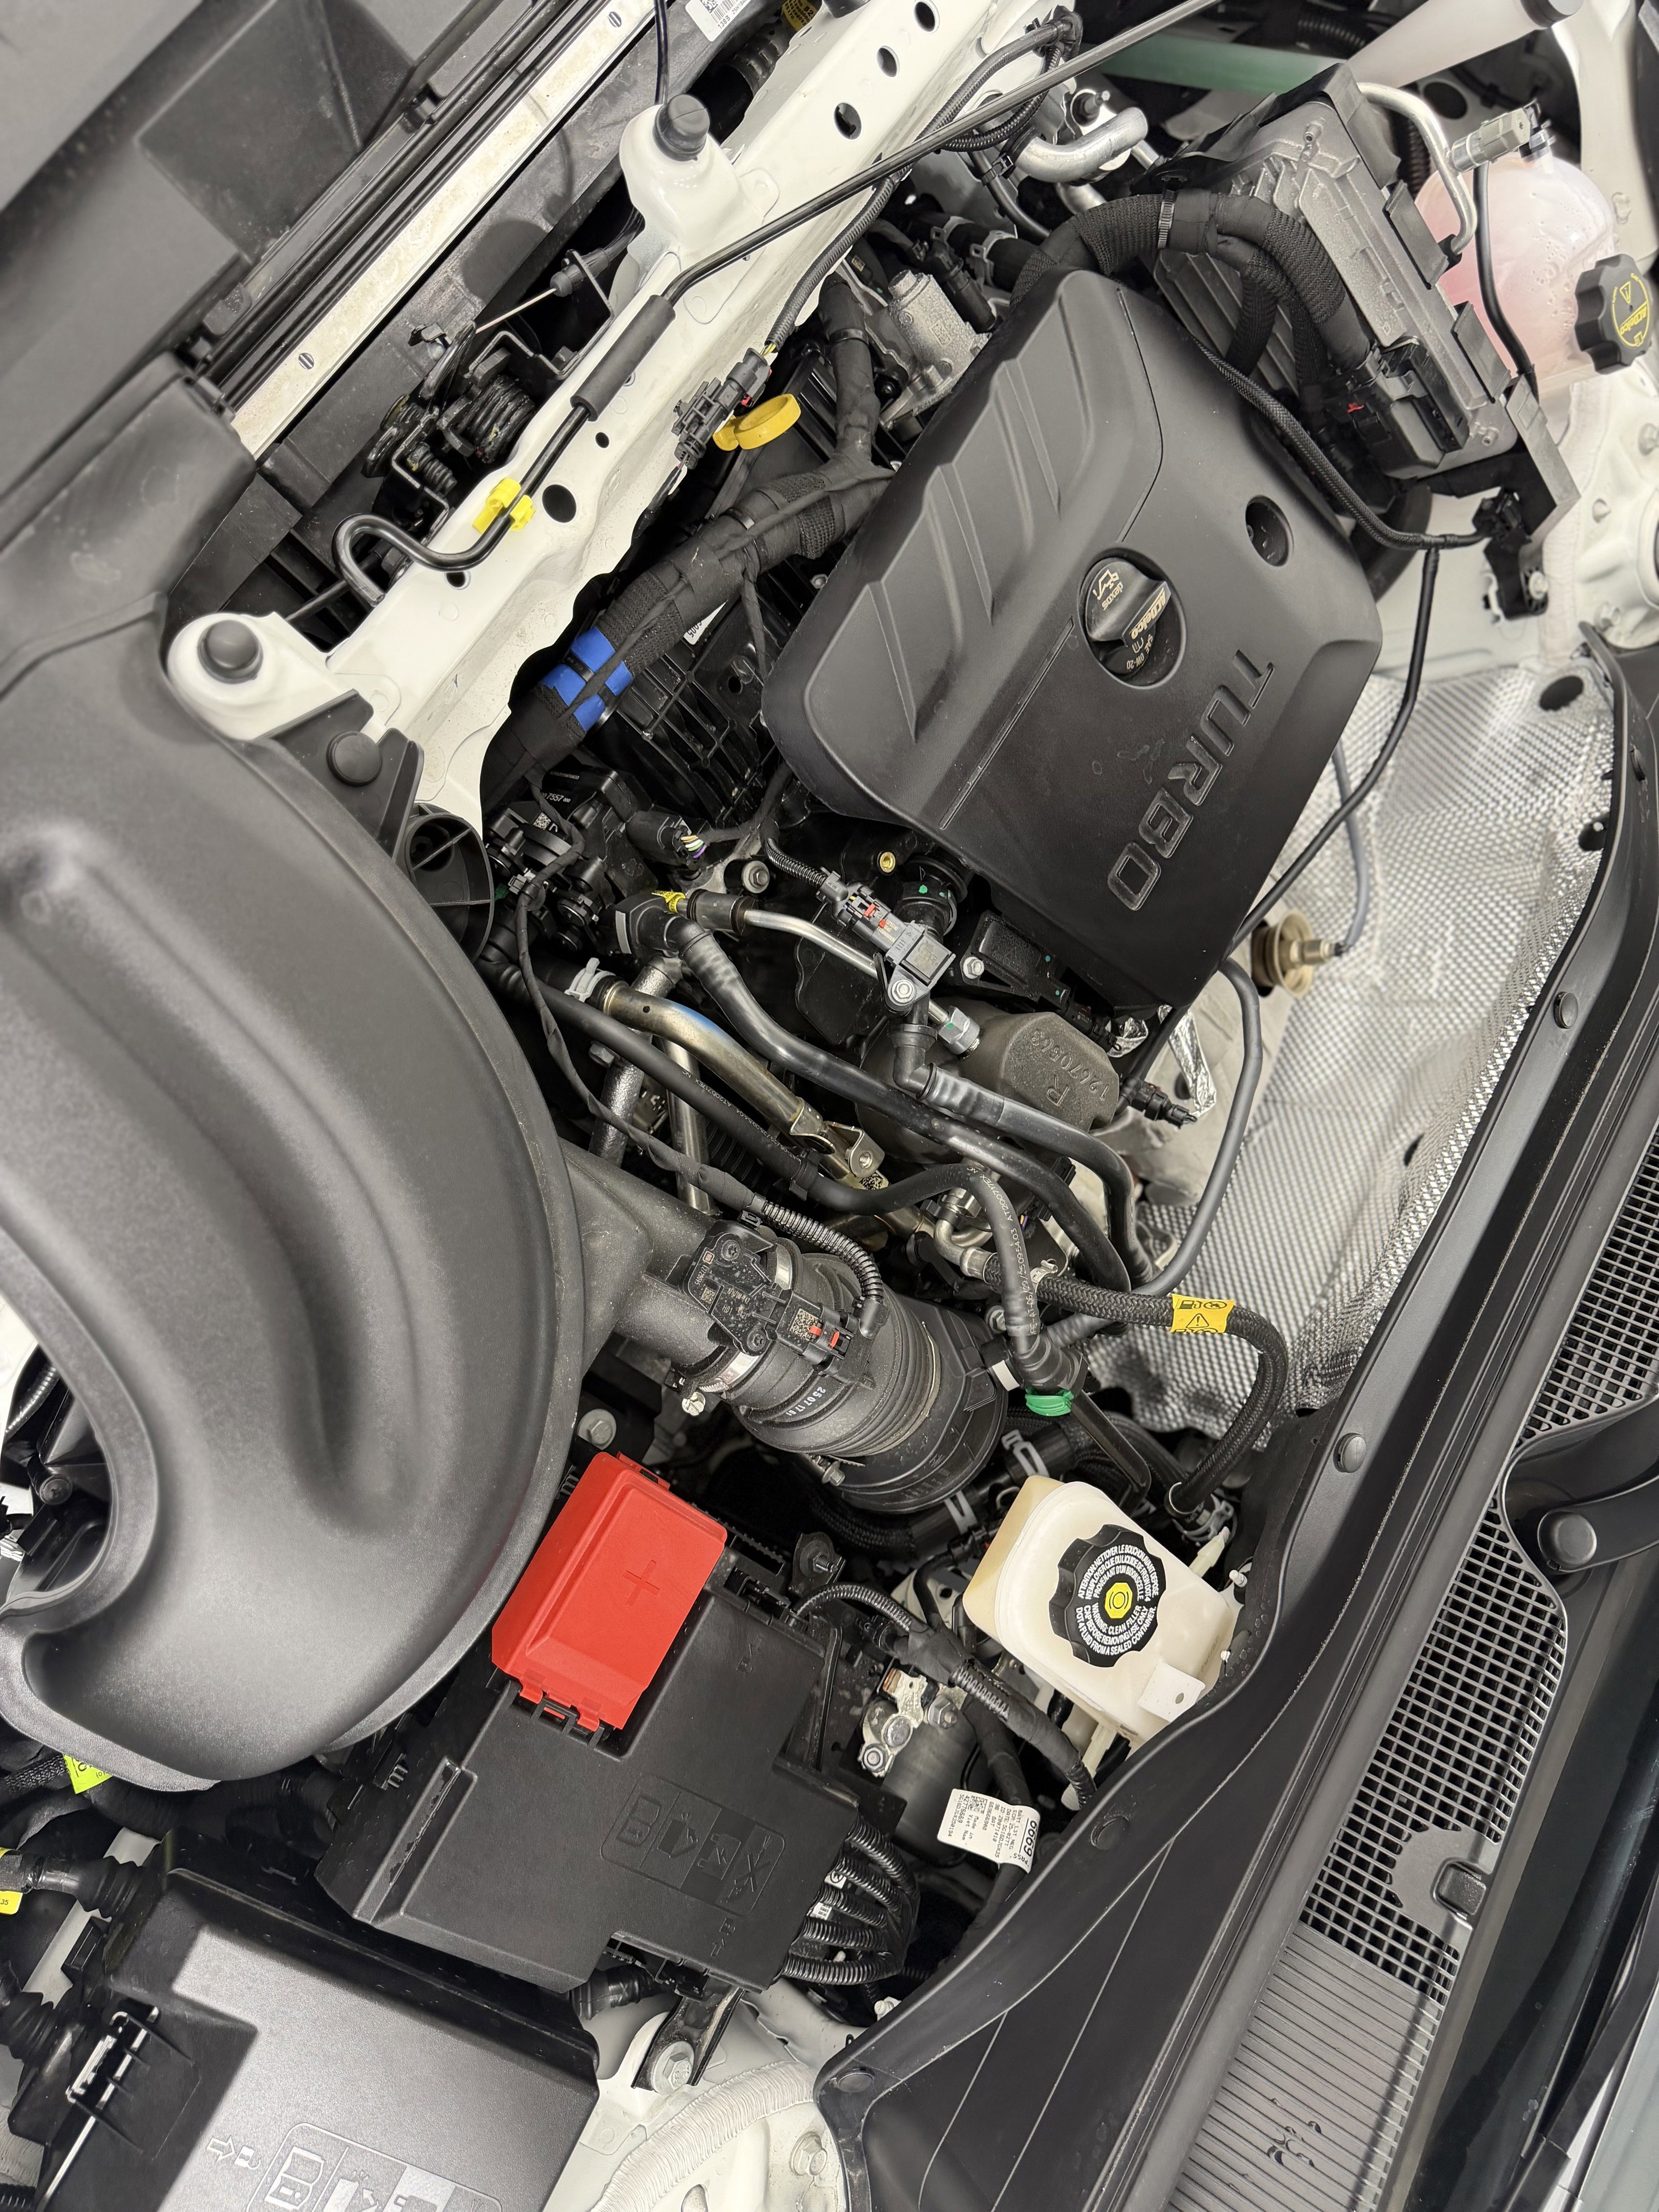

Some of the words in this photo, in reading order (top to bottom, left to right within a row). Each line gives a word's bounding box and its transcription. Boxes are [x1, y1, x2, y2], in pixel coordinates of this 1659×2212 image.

[1101, 581, 1122, 610] dexos
[1130, 590, 1166, 640] ACDelco
[1144, 634, 1153, 653] SAE
[1125, 653, 1146, 670] 0W-20
[1108, 650, 1275, 911] TURBO
[1047, 1074, 1068, 1106] R
[1095, 1545, 1118, 1568] NETTOYER
[1118, 1544, 1124, 1554] LE
[1124, 1545, 1145, 1560] BOUCHON
[1142, 1553, 1155, 1572] AVANT
[1104, 1558, 1115, 1569] QUE
[1114, 1556, 1121, 1564] DU
[1121, 1555, 1138, 1566] LIQUIDE
[1137, 1561, 1143, 1571] DE
[1141, 1567, 1150, 1585] FREIN
[1093, 1567, 1116, 1598] PROVENANT
[1135, 1576, 1143, 1601] SCELLE
[1087, 1618, 1103, 1641] BEFORE
[1129, 1625, 1139, 1636] USE
[1138, 1605, 1148, 1627] ONLY
[1092, 1602, 1108, 1633] WARNING:
[1109, 1624, 1126, 1635] CLEAN
[1127, 1605, 1141, 1625] FILLER
[1079, 1626, 1091, 1645] FLUID
[1090, 1642, 1106, 1654] FROM
[1110, 1642, 1131, 1655] SEALED
[1023, 1820, 1038, 1857] 6669
